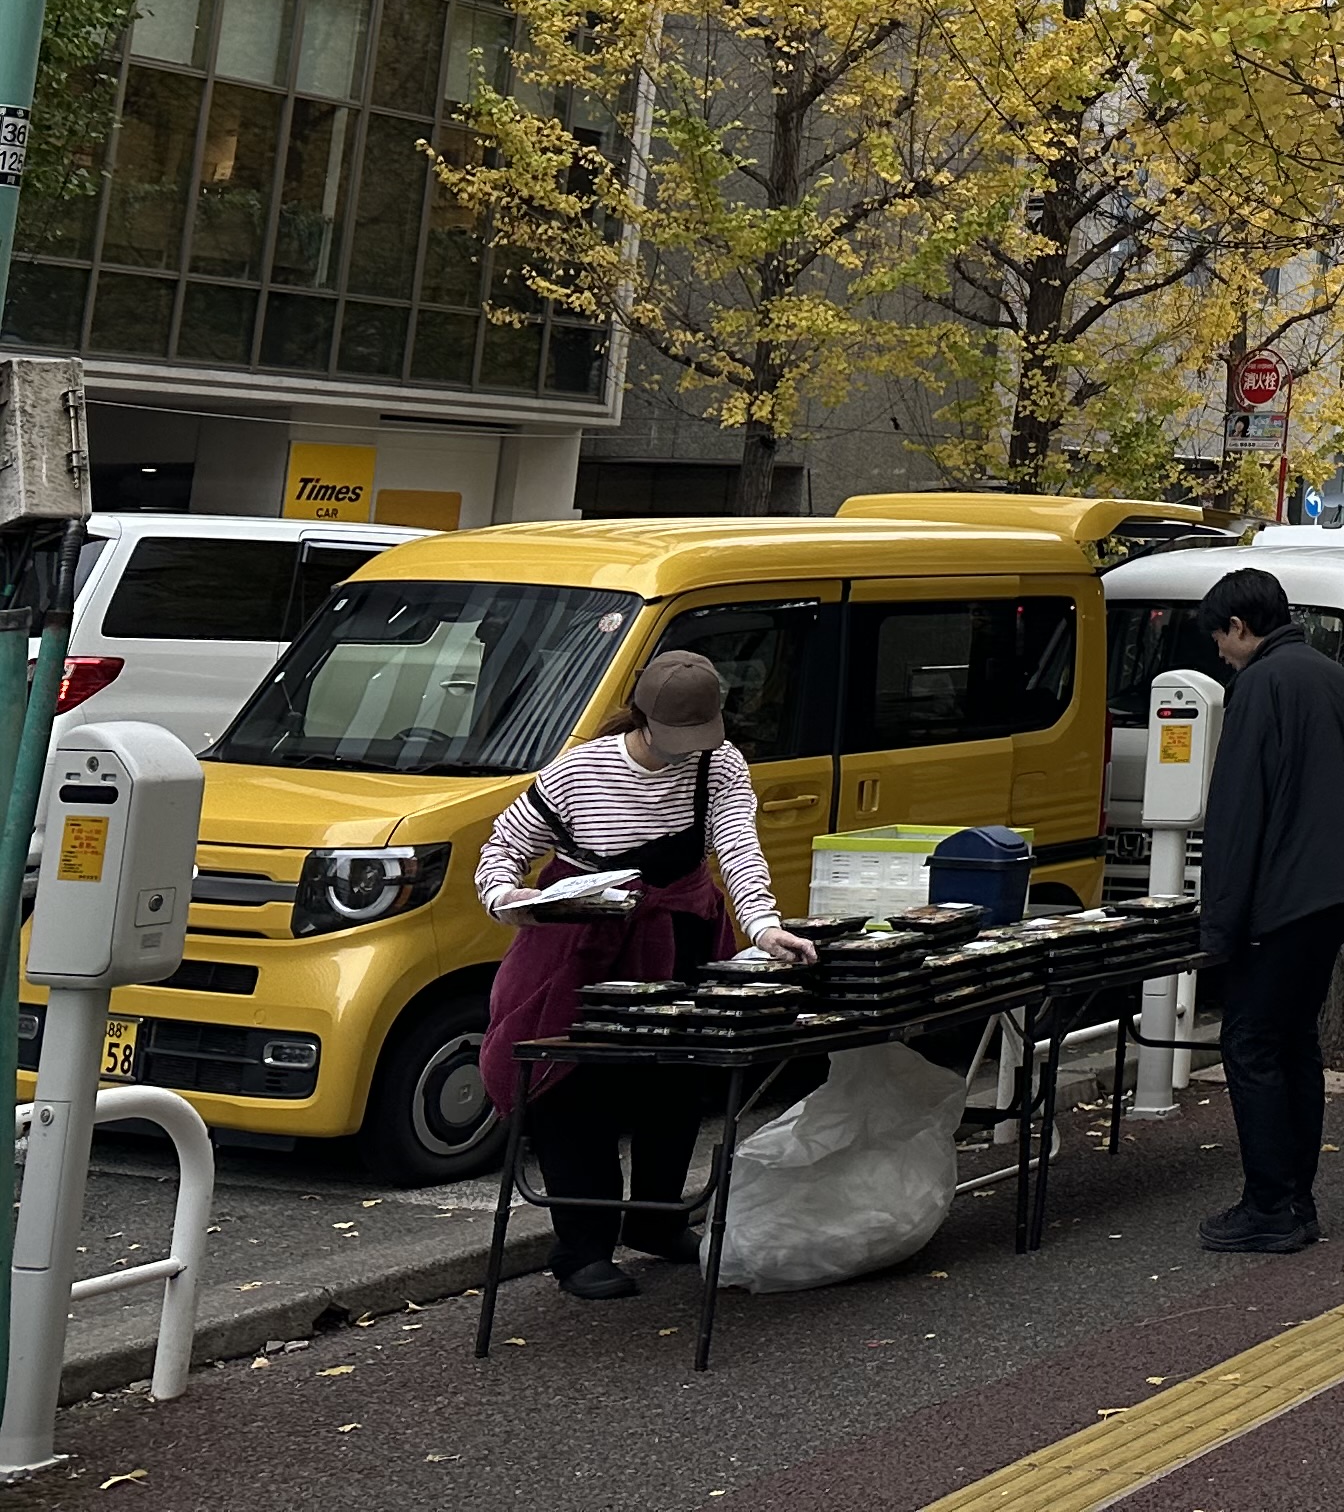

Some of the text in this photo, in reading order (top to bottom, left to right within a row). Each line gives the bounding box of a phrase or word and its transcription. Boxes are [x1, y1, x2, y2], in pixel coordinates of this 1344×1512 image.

[3, 122, 27, 145] 36
[1243, 371, 1278, 391] 消火栓
[295, 477, 364, 503] Times
[316, 507, 339, 519] CAR
